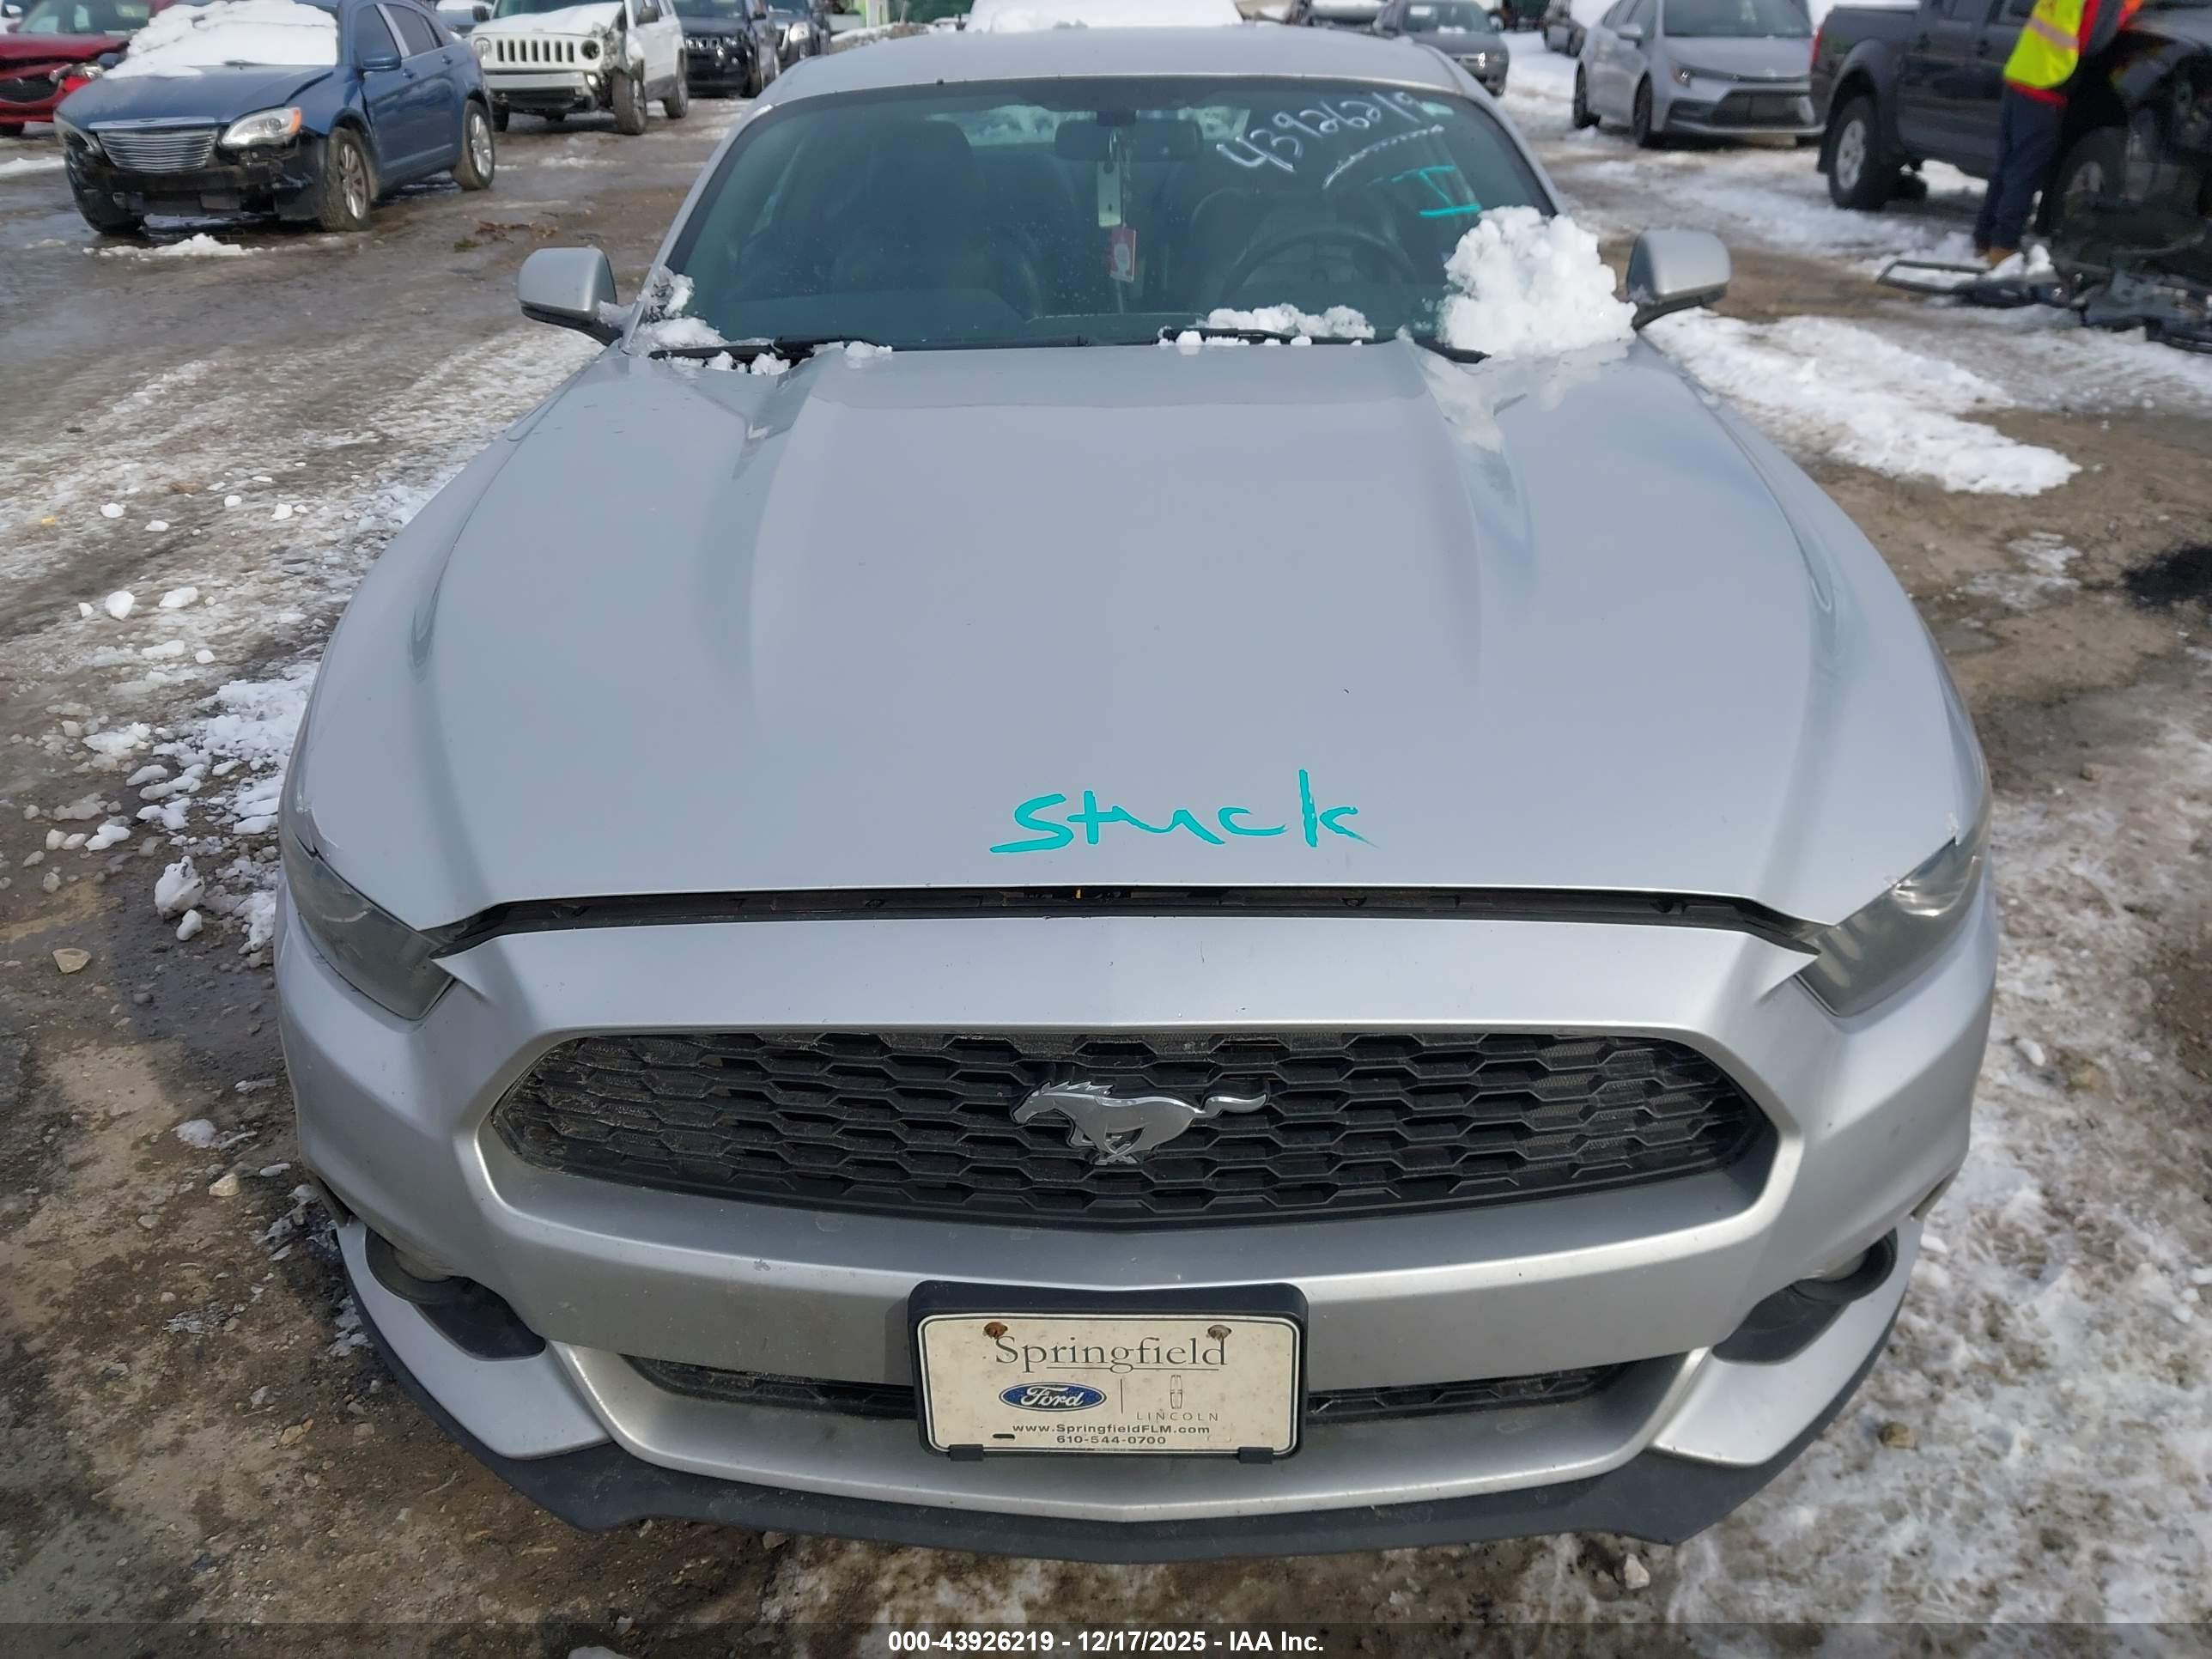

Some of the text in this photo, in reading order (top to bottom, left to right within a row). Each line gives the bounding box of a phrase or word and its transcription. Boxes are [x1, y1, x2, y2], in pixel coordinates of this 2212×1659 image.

[990, 769, 1379, 854] Stuck
[995, 1334, 1228, 1374] Springfield
[1020, 1384, 1085, 1407] Ford
[1136, 1411, 1218, 1422] LINCOLN
[1012, 1424, 1211, 1435] www.SpringfieldFLM.com
[1056, 1435, 1166, 1444] 610-544-0700
